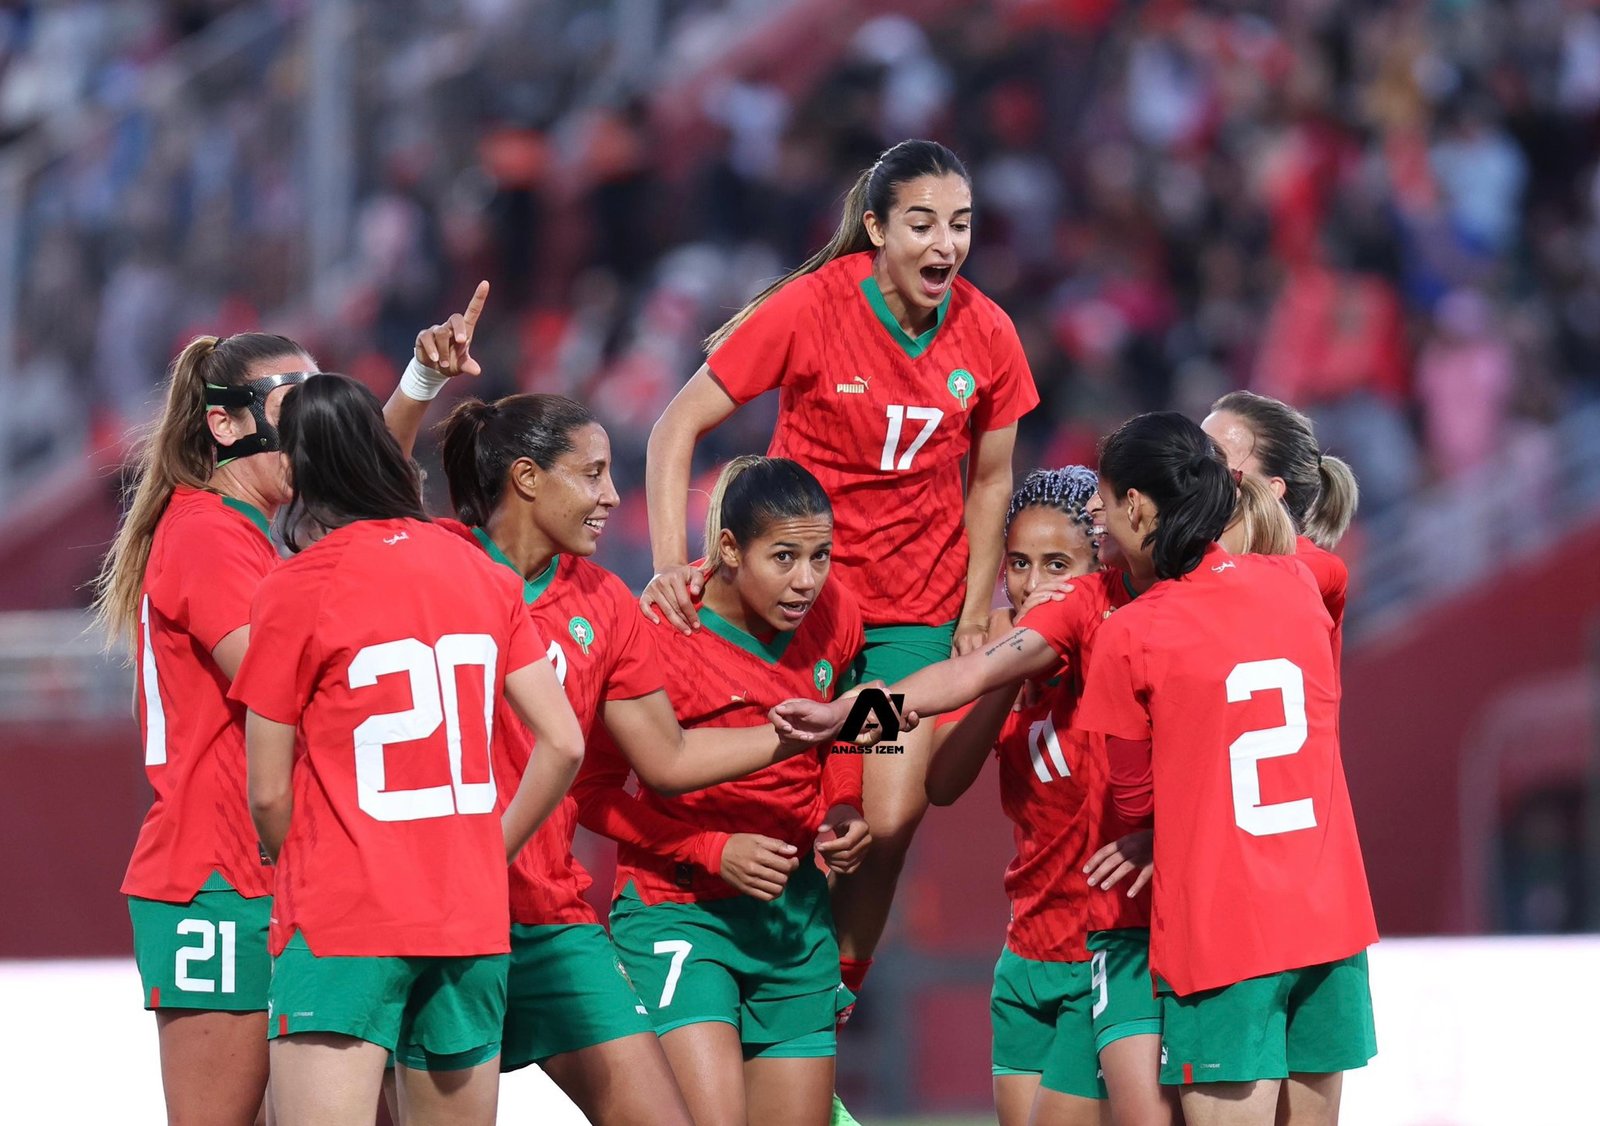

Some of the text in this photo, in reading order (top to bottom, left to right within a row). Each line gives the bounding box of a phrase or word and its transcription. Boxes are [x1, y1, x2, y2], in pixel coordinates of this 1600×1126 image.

[836, 383, 865, 394] PUMA
[880, 404, 945, 471] 17
[347, 633, 499, 822] 20
[1028, 710, 1071, 783] 11
[1225, 657, 1318, 837] 2
[175, 918, 236, 993] 21
[653, 939, 693, 1008] 7
[1091, 950, 1108, 1019] 9
